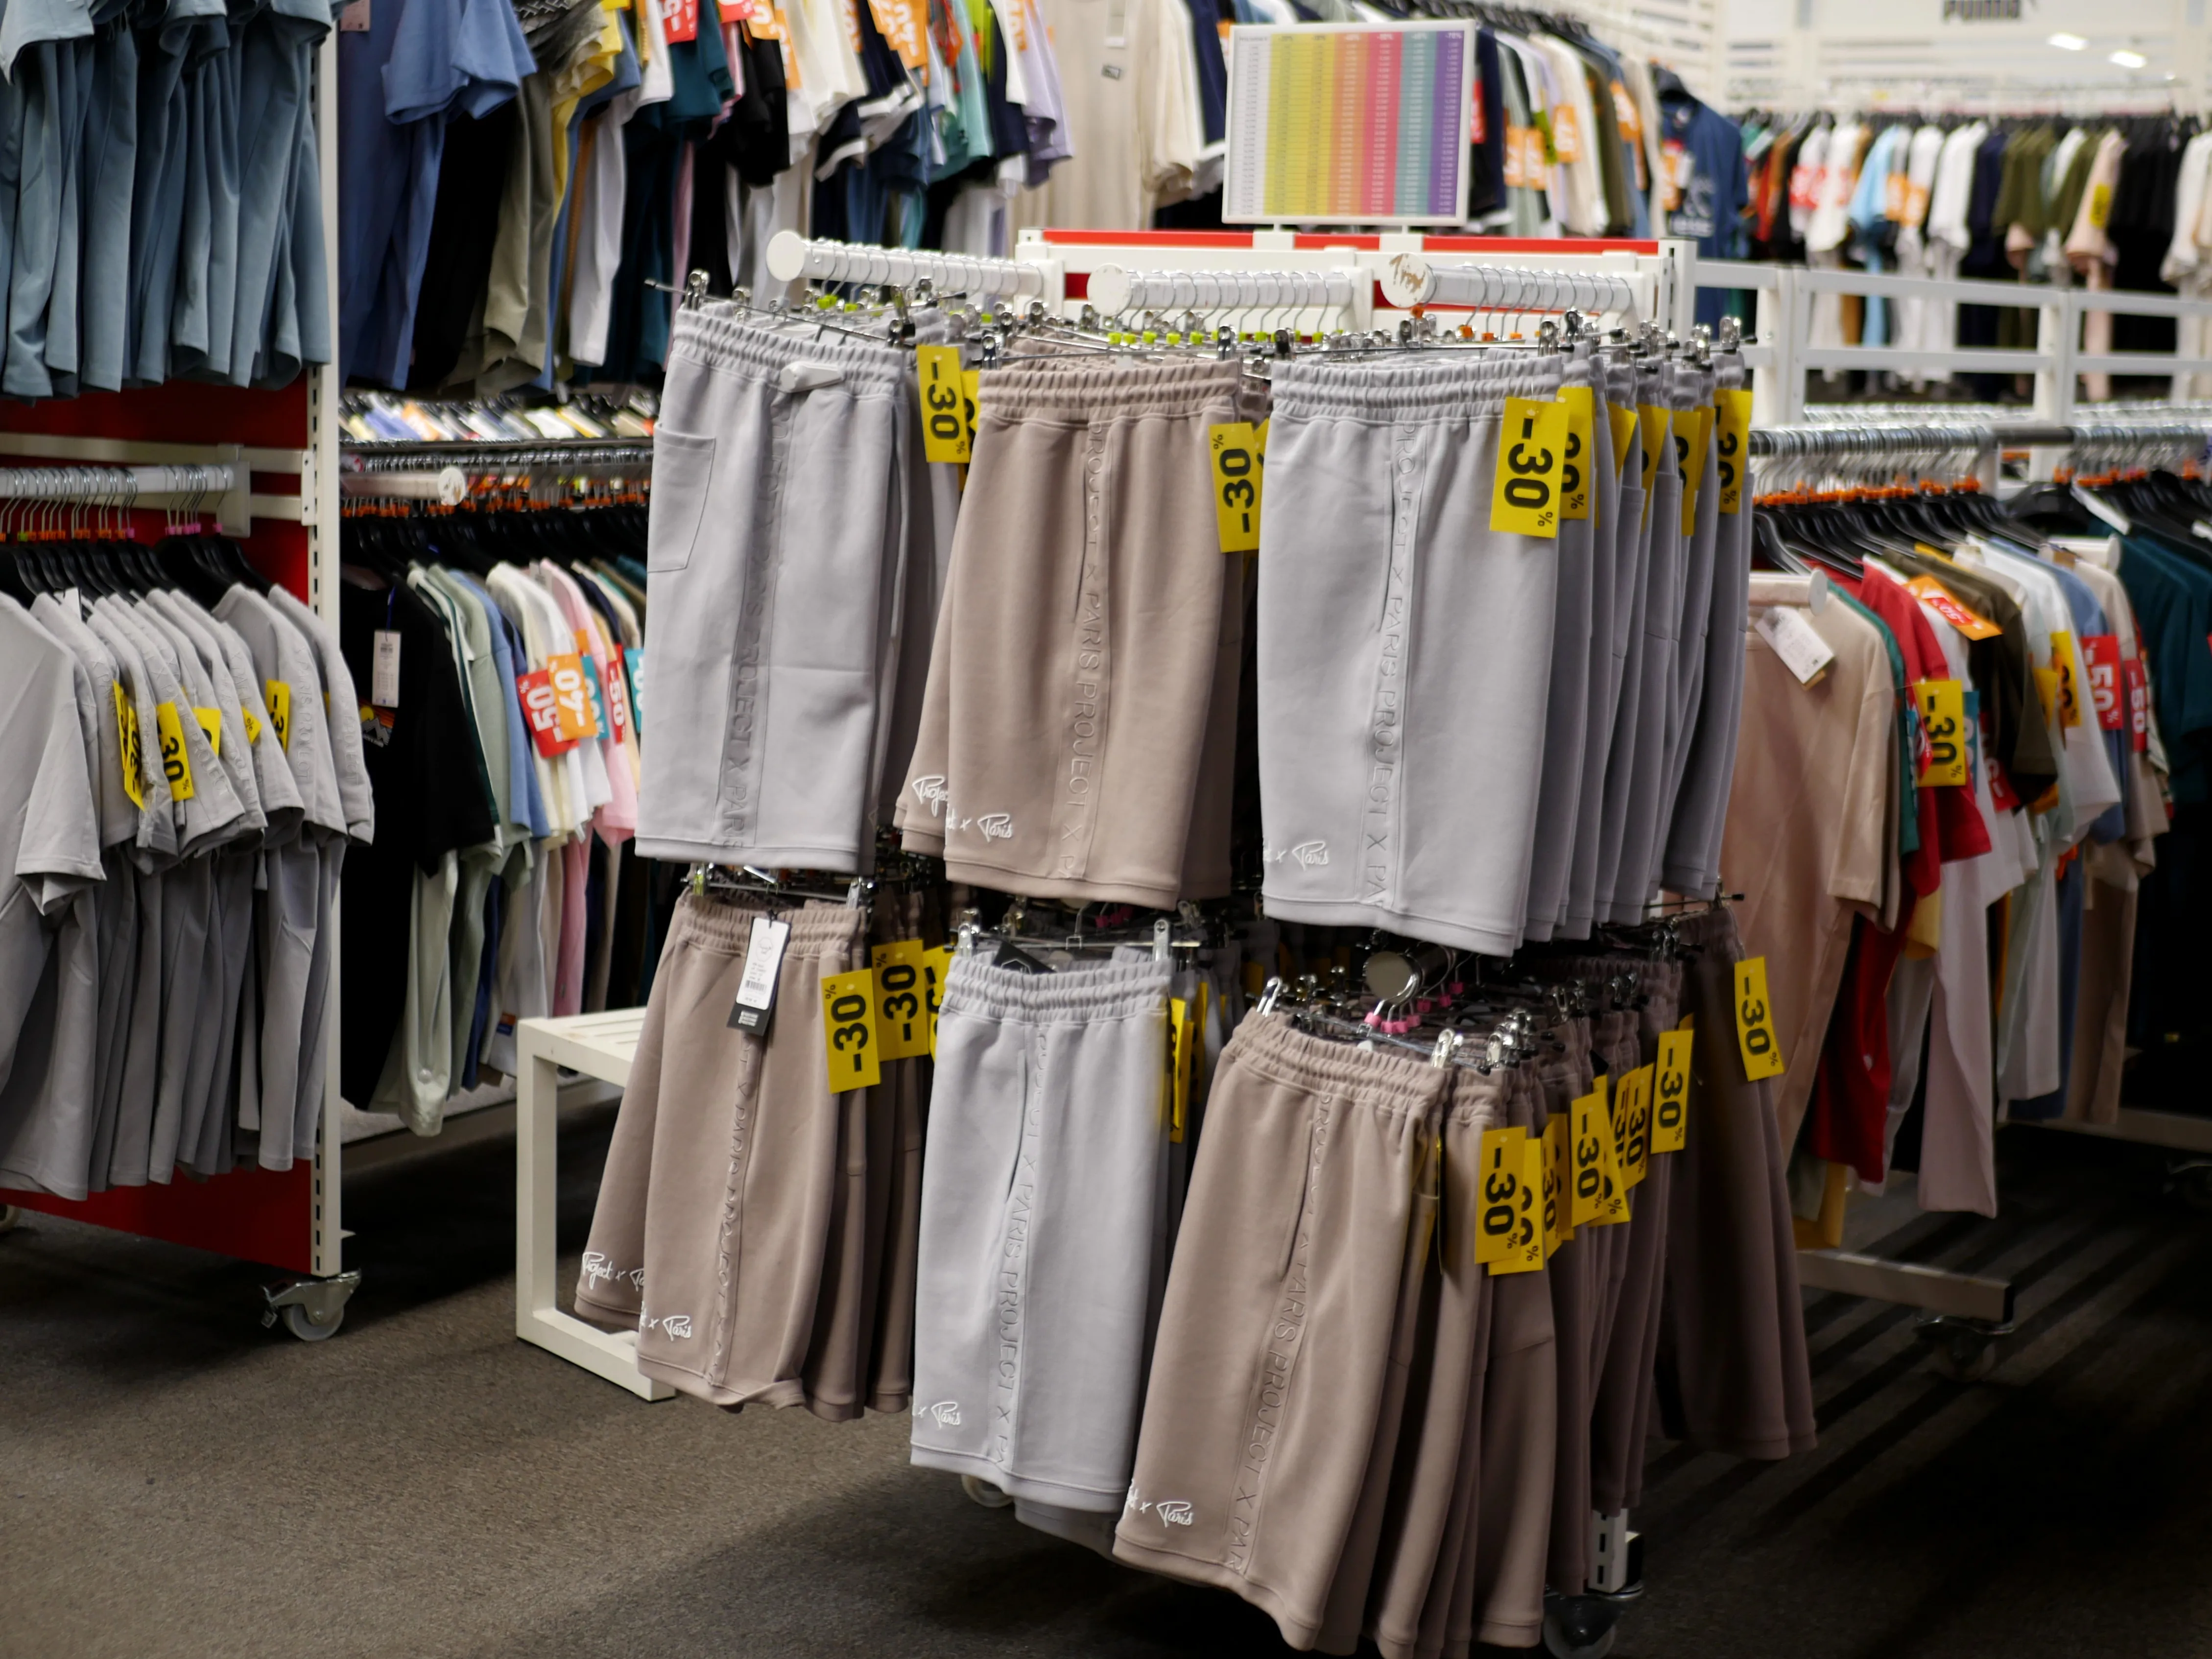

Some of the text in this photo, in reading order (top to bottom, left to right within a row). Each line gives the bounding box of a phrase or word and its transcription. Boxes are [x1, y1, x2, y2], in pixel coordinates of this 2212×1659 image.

[1086, 563, 1101, 581] X
[1391, 567, 1403, 584] X
[1078, 592, 1101, 670] PARIS
[1380, 597, 1403, 678] PARIS
[1066, 682, 1097, 807] PROJECT
[1367, 690, 1396, 821] PROJECT
[727, 757, 750, 772] X
[977, 814, 1014, 843] Paris
[1062, 824, 1082, 841] X
[1366, 834, 1387, 851] X
[1291, 841, 1329, 872] Paris
[1005, 1183, 1034, 1258] PARIS
[662, 1315, 692, 1342] Paris
[998, 1271, 1019, 1391] PROJECT
[930, 1401, 961, 1430] Paris
[997, 1405, 1010, 1424] X
[1244, 1350, 1288, 1483] PROJECT
[1236, 1486, 1258, 1510] X
[1156, 1501, 1194, 1528] Paris
